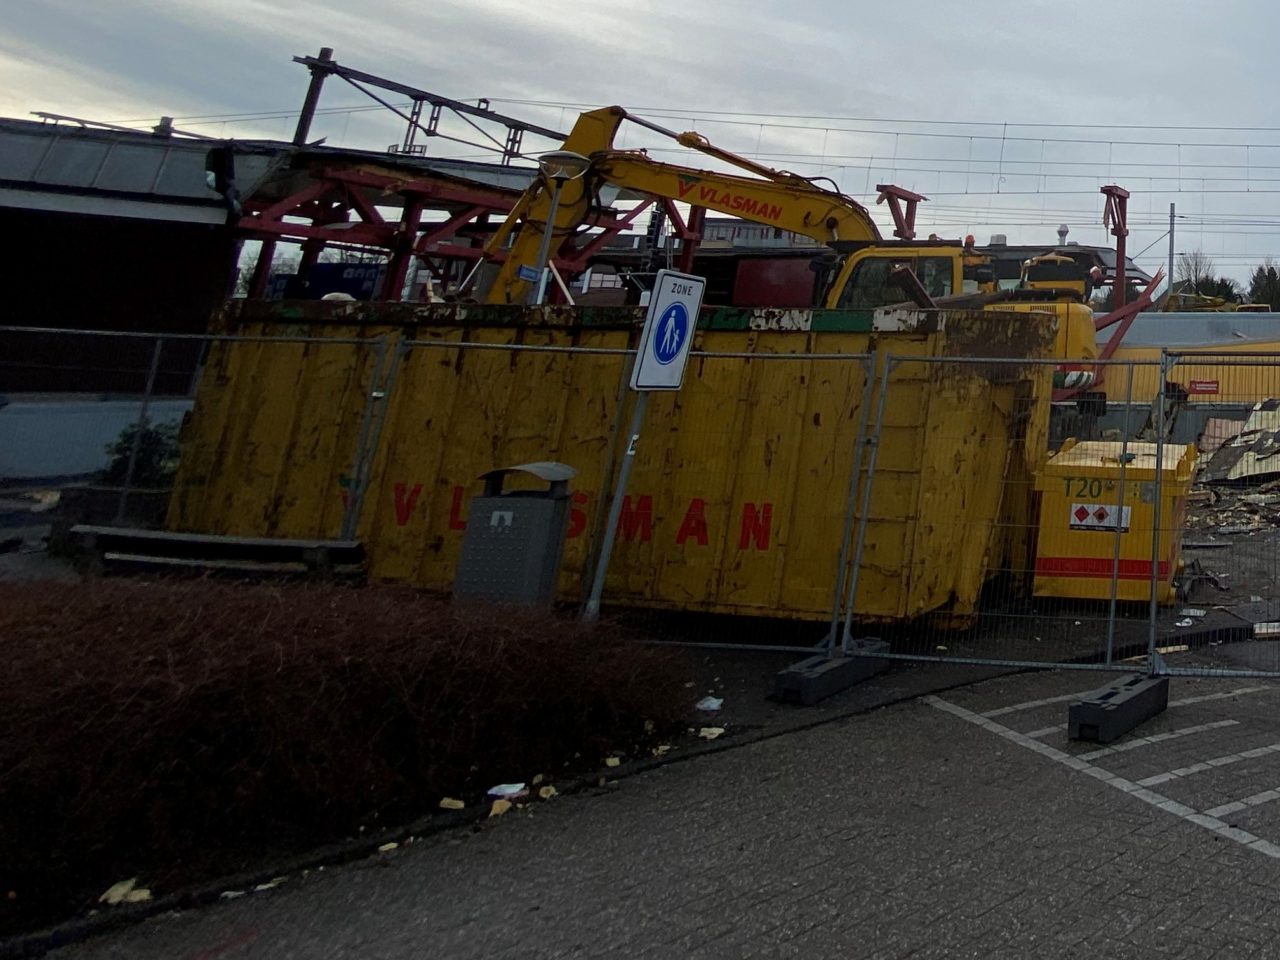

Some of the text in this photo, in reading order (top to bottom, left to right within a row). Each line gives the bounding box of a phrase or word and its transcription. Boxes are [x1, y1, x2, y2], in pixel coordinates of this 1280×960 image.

[700, 185, 782, 220] VLASMAN
[671, 283, 693, 296] ZONE
[393, 483, 772, 551] VLSMAN
